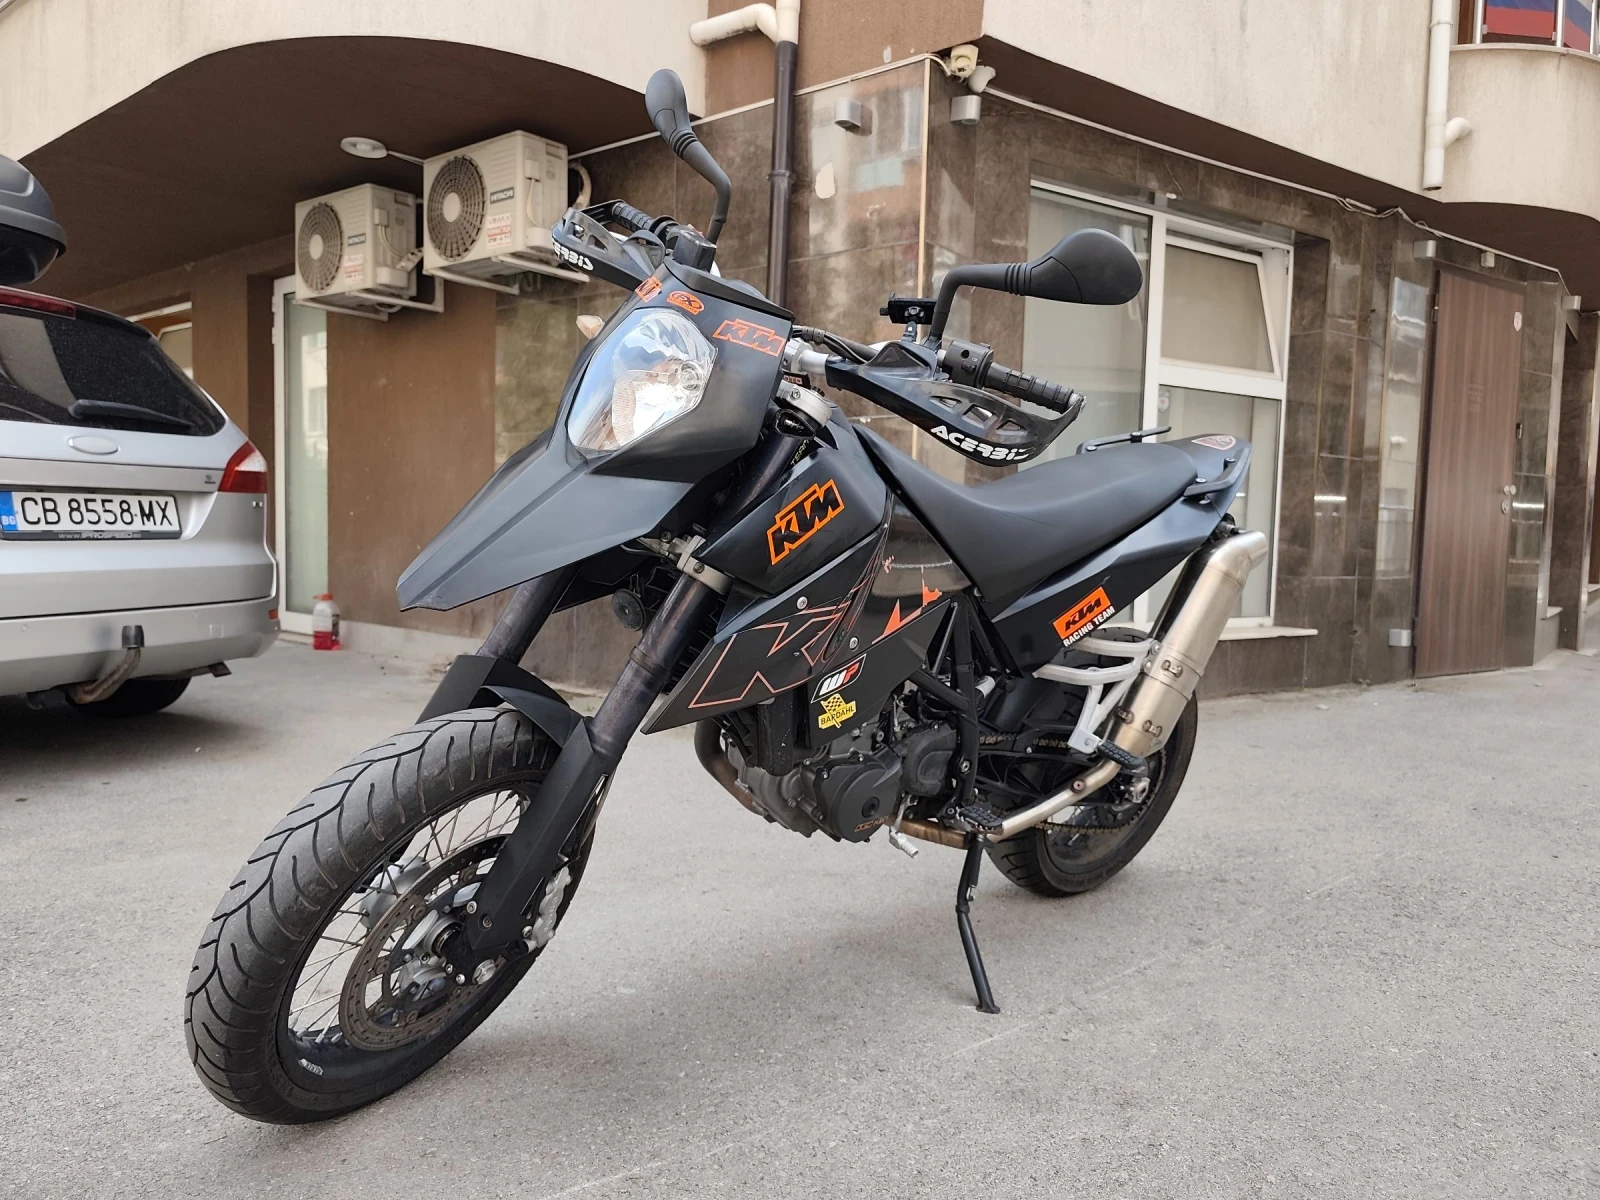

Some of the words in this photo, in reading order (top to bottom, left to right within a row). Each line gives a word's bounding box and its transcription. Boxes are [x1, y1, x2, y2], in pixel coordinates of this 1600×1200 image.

[491, 189, 513, 203] HITACHI
[713, 319, 787, 357] KTM
[2, 515, 17, 526] BG
[21, 497, 61, 525] CB
[68, 498, 134, 526] 8558
[138, 500, 173, 526] MX
[767, 479, 845, 566] KTM
[1063, 622, 1094, 647] RACING
[1092, 605, 1116, 626] TEAM
[1064, 597, 1102, 633] KTM
[820, 706, 855, 725] BARDAHL
